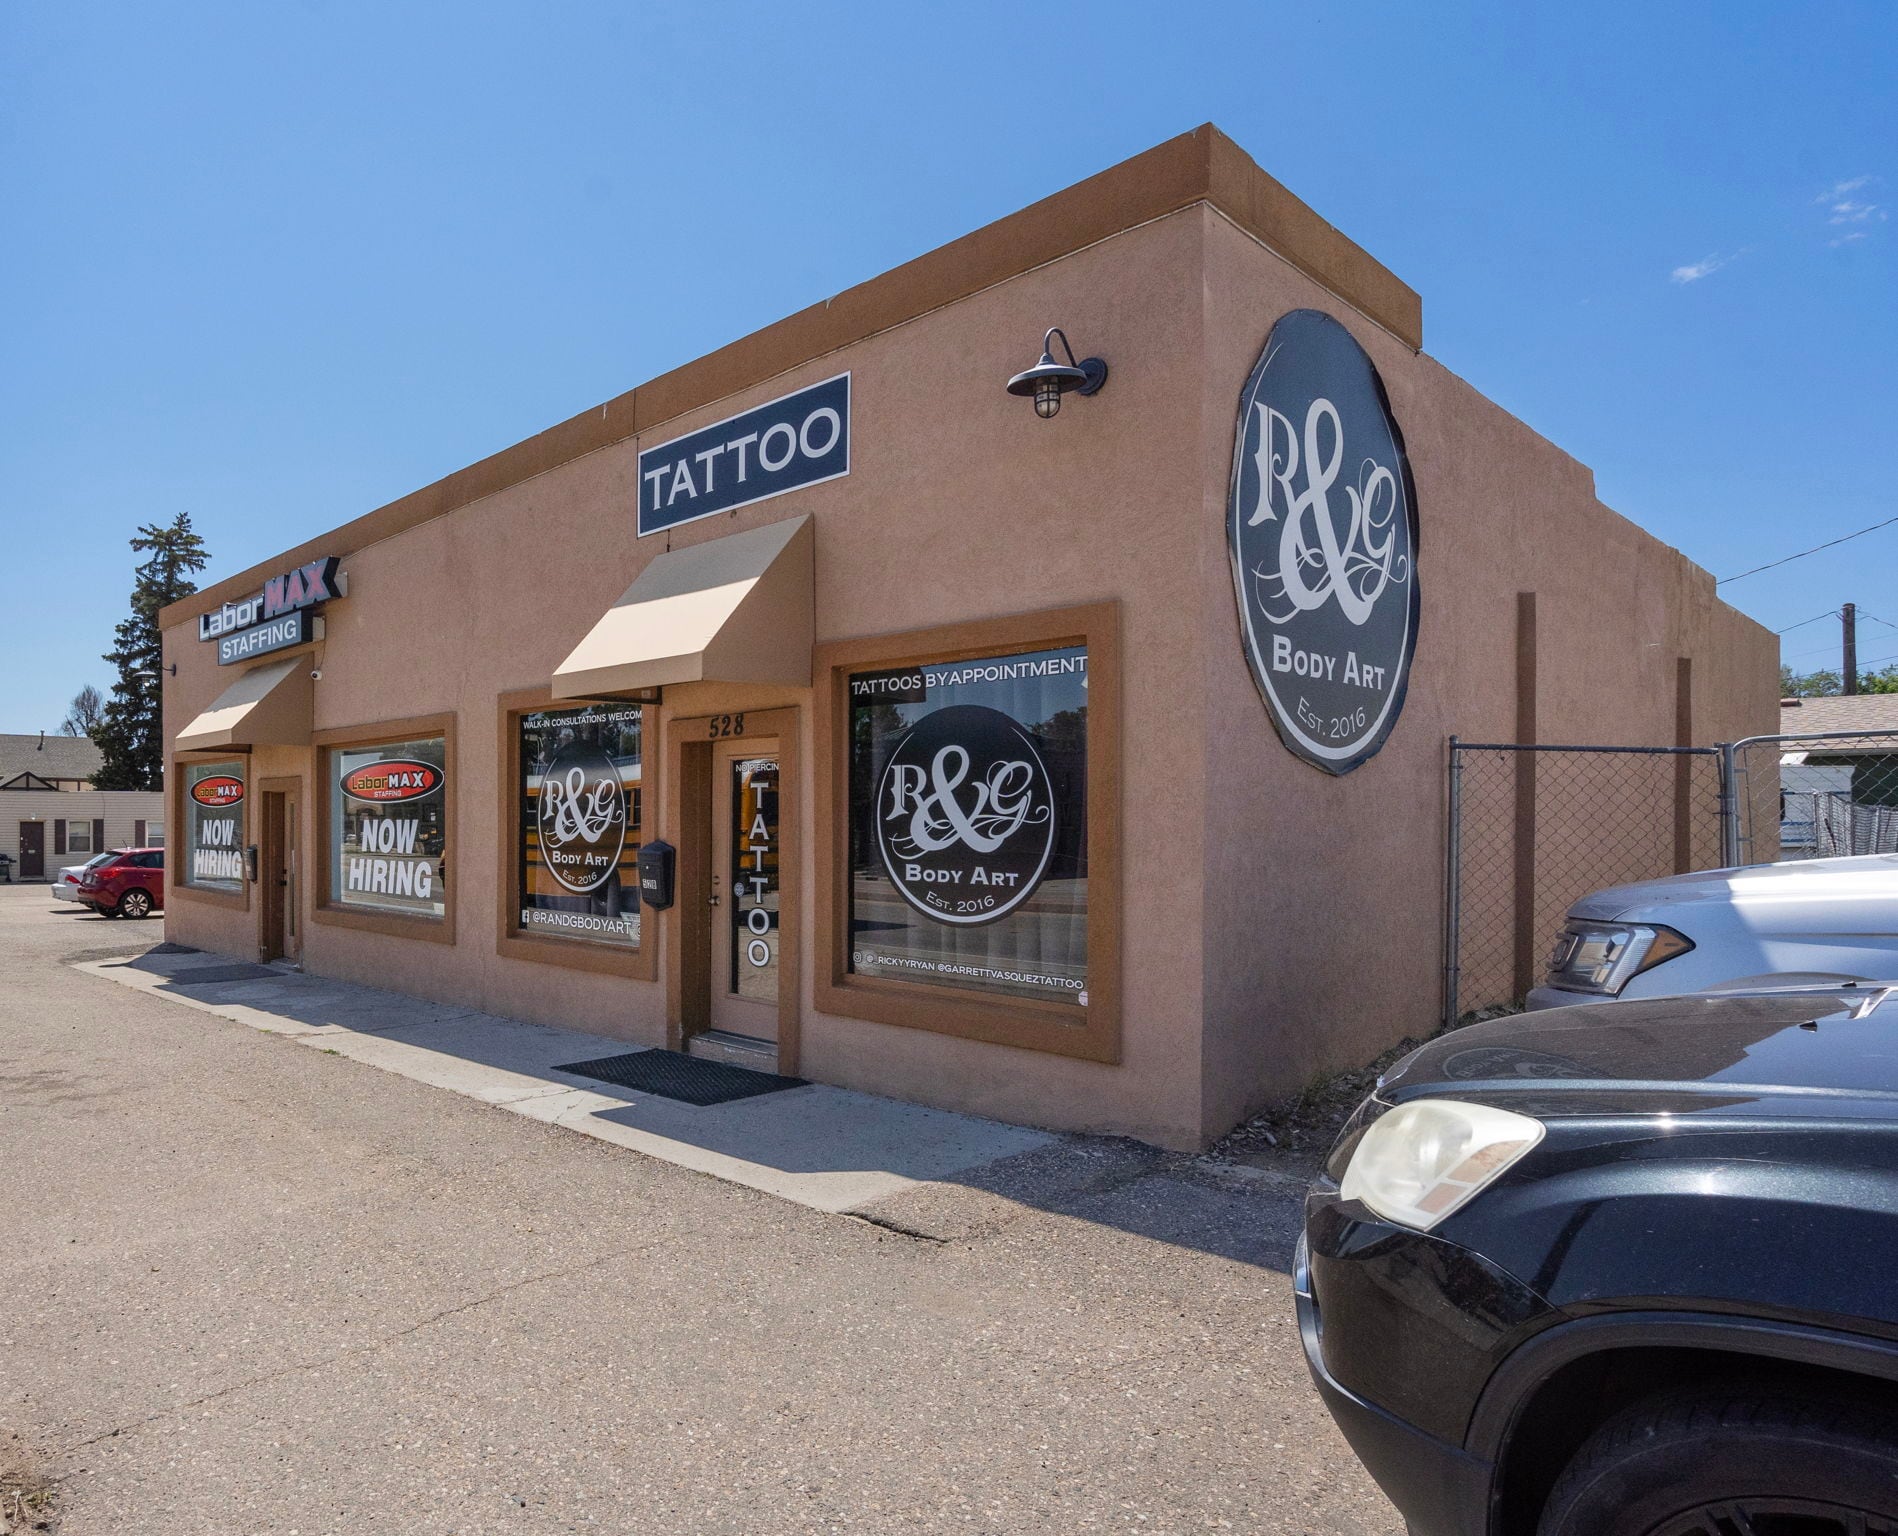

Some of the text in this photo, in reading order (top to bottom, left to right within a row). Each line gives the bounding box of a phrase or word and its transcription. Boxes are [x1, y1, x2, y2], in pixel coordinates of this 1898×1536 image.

[644, 407, 841, 510] TATTOO
[1248, 398, 1408, 625] R&G
[222, 619, 297, 659] STAFFING
[851, 656, 1088, 695] TATTOOS BY APPOINTMENT
[523, 710, 642, 729] WALK-IN CONSULTATIONS WELCOM
[709, 712, 744, 738] 528
[1330, 706, 1366, 738] 2016
[735, 764, 748, 772] NO
[374, 790, 402, 798] STAFFING
[542, 767, 624, 848] R&G
[885, 745, 1049, 859] R&G
[202, 819, 234, 846] NOW
[361, 818, 418, 854] NOW
[194, 848, 242, 879] HIRING
[348, 858, 432, 898] HIRING
[578, 871, 597, 885] 2016
[748, 782, 770, 967] TATTOO
[957, 895, 995, 912] 2016
[532, 912, 631, 934] @RANDGBODYART
[938, 963, 1084, 989] @GARRETTVASQUEZTATTOO
